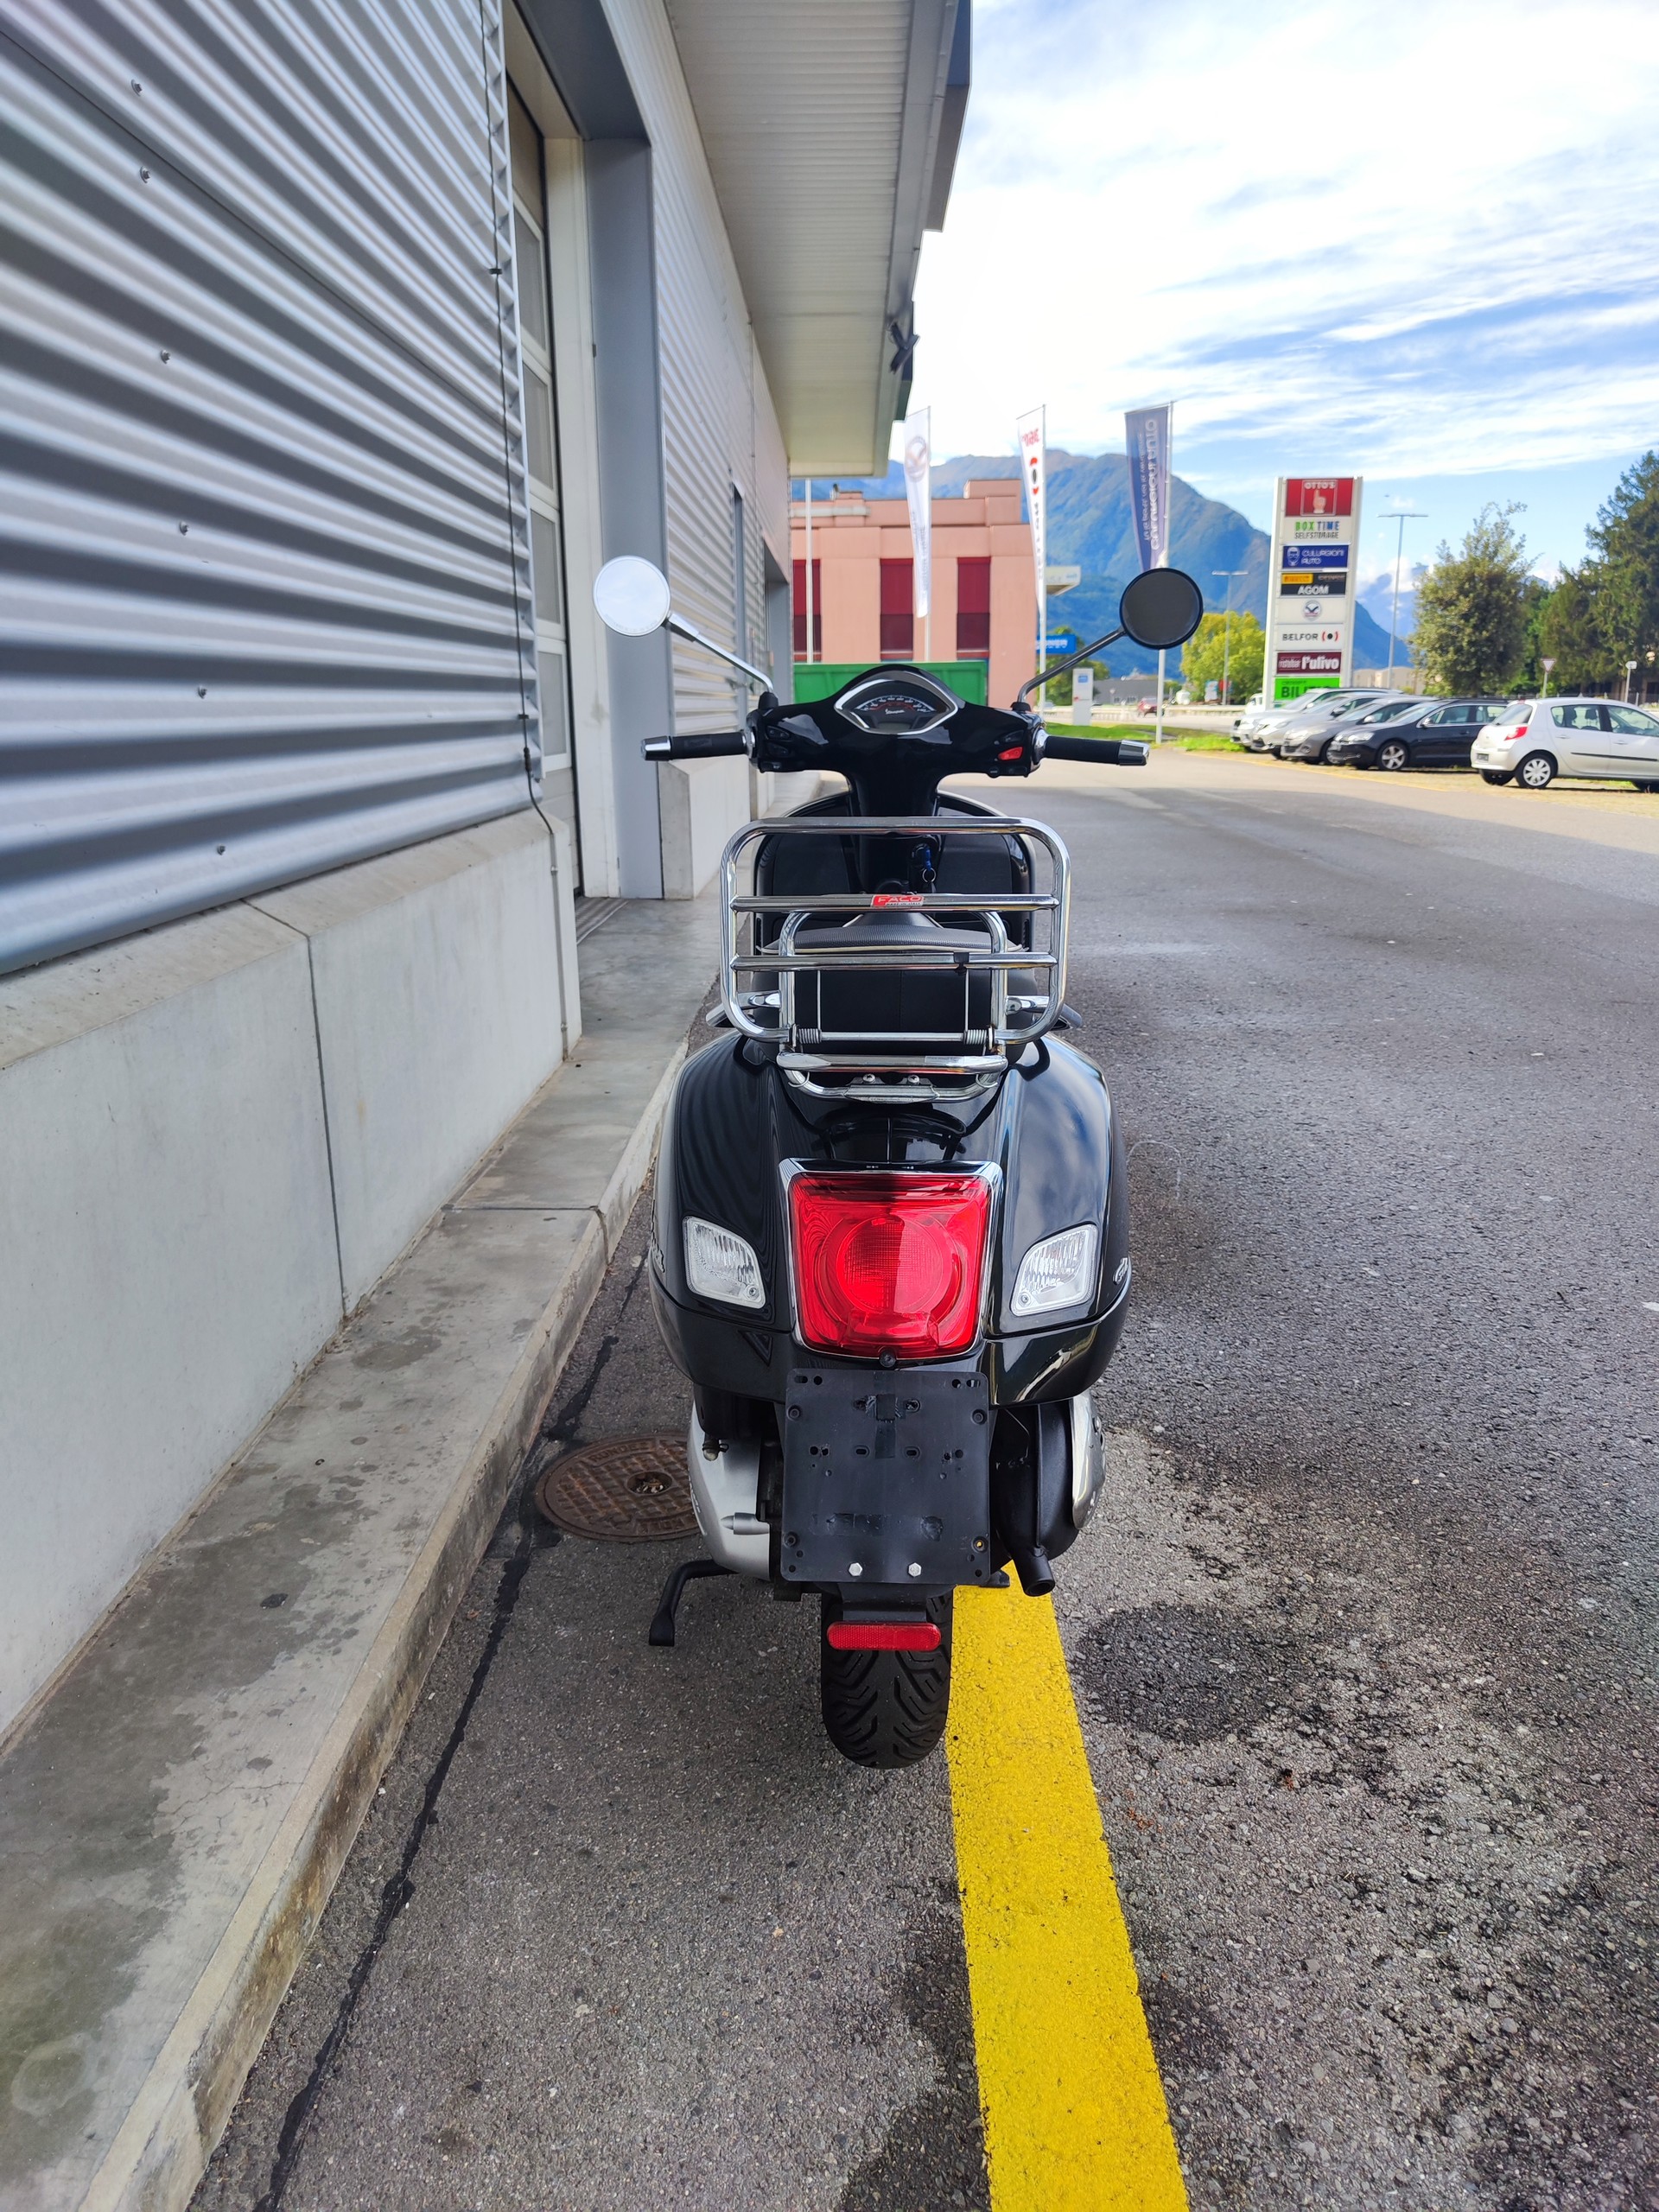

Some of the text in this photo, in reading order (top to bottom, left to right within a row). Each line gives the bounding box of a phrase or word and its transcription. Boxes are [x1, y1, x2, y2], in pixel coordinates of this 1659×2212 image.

[1295, 521, 1339, 531] BOX TIME
[1298, 585, 1329, 594] AGOM
